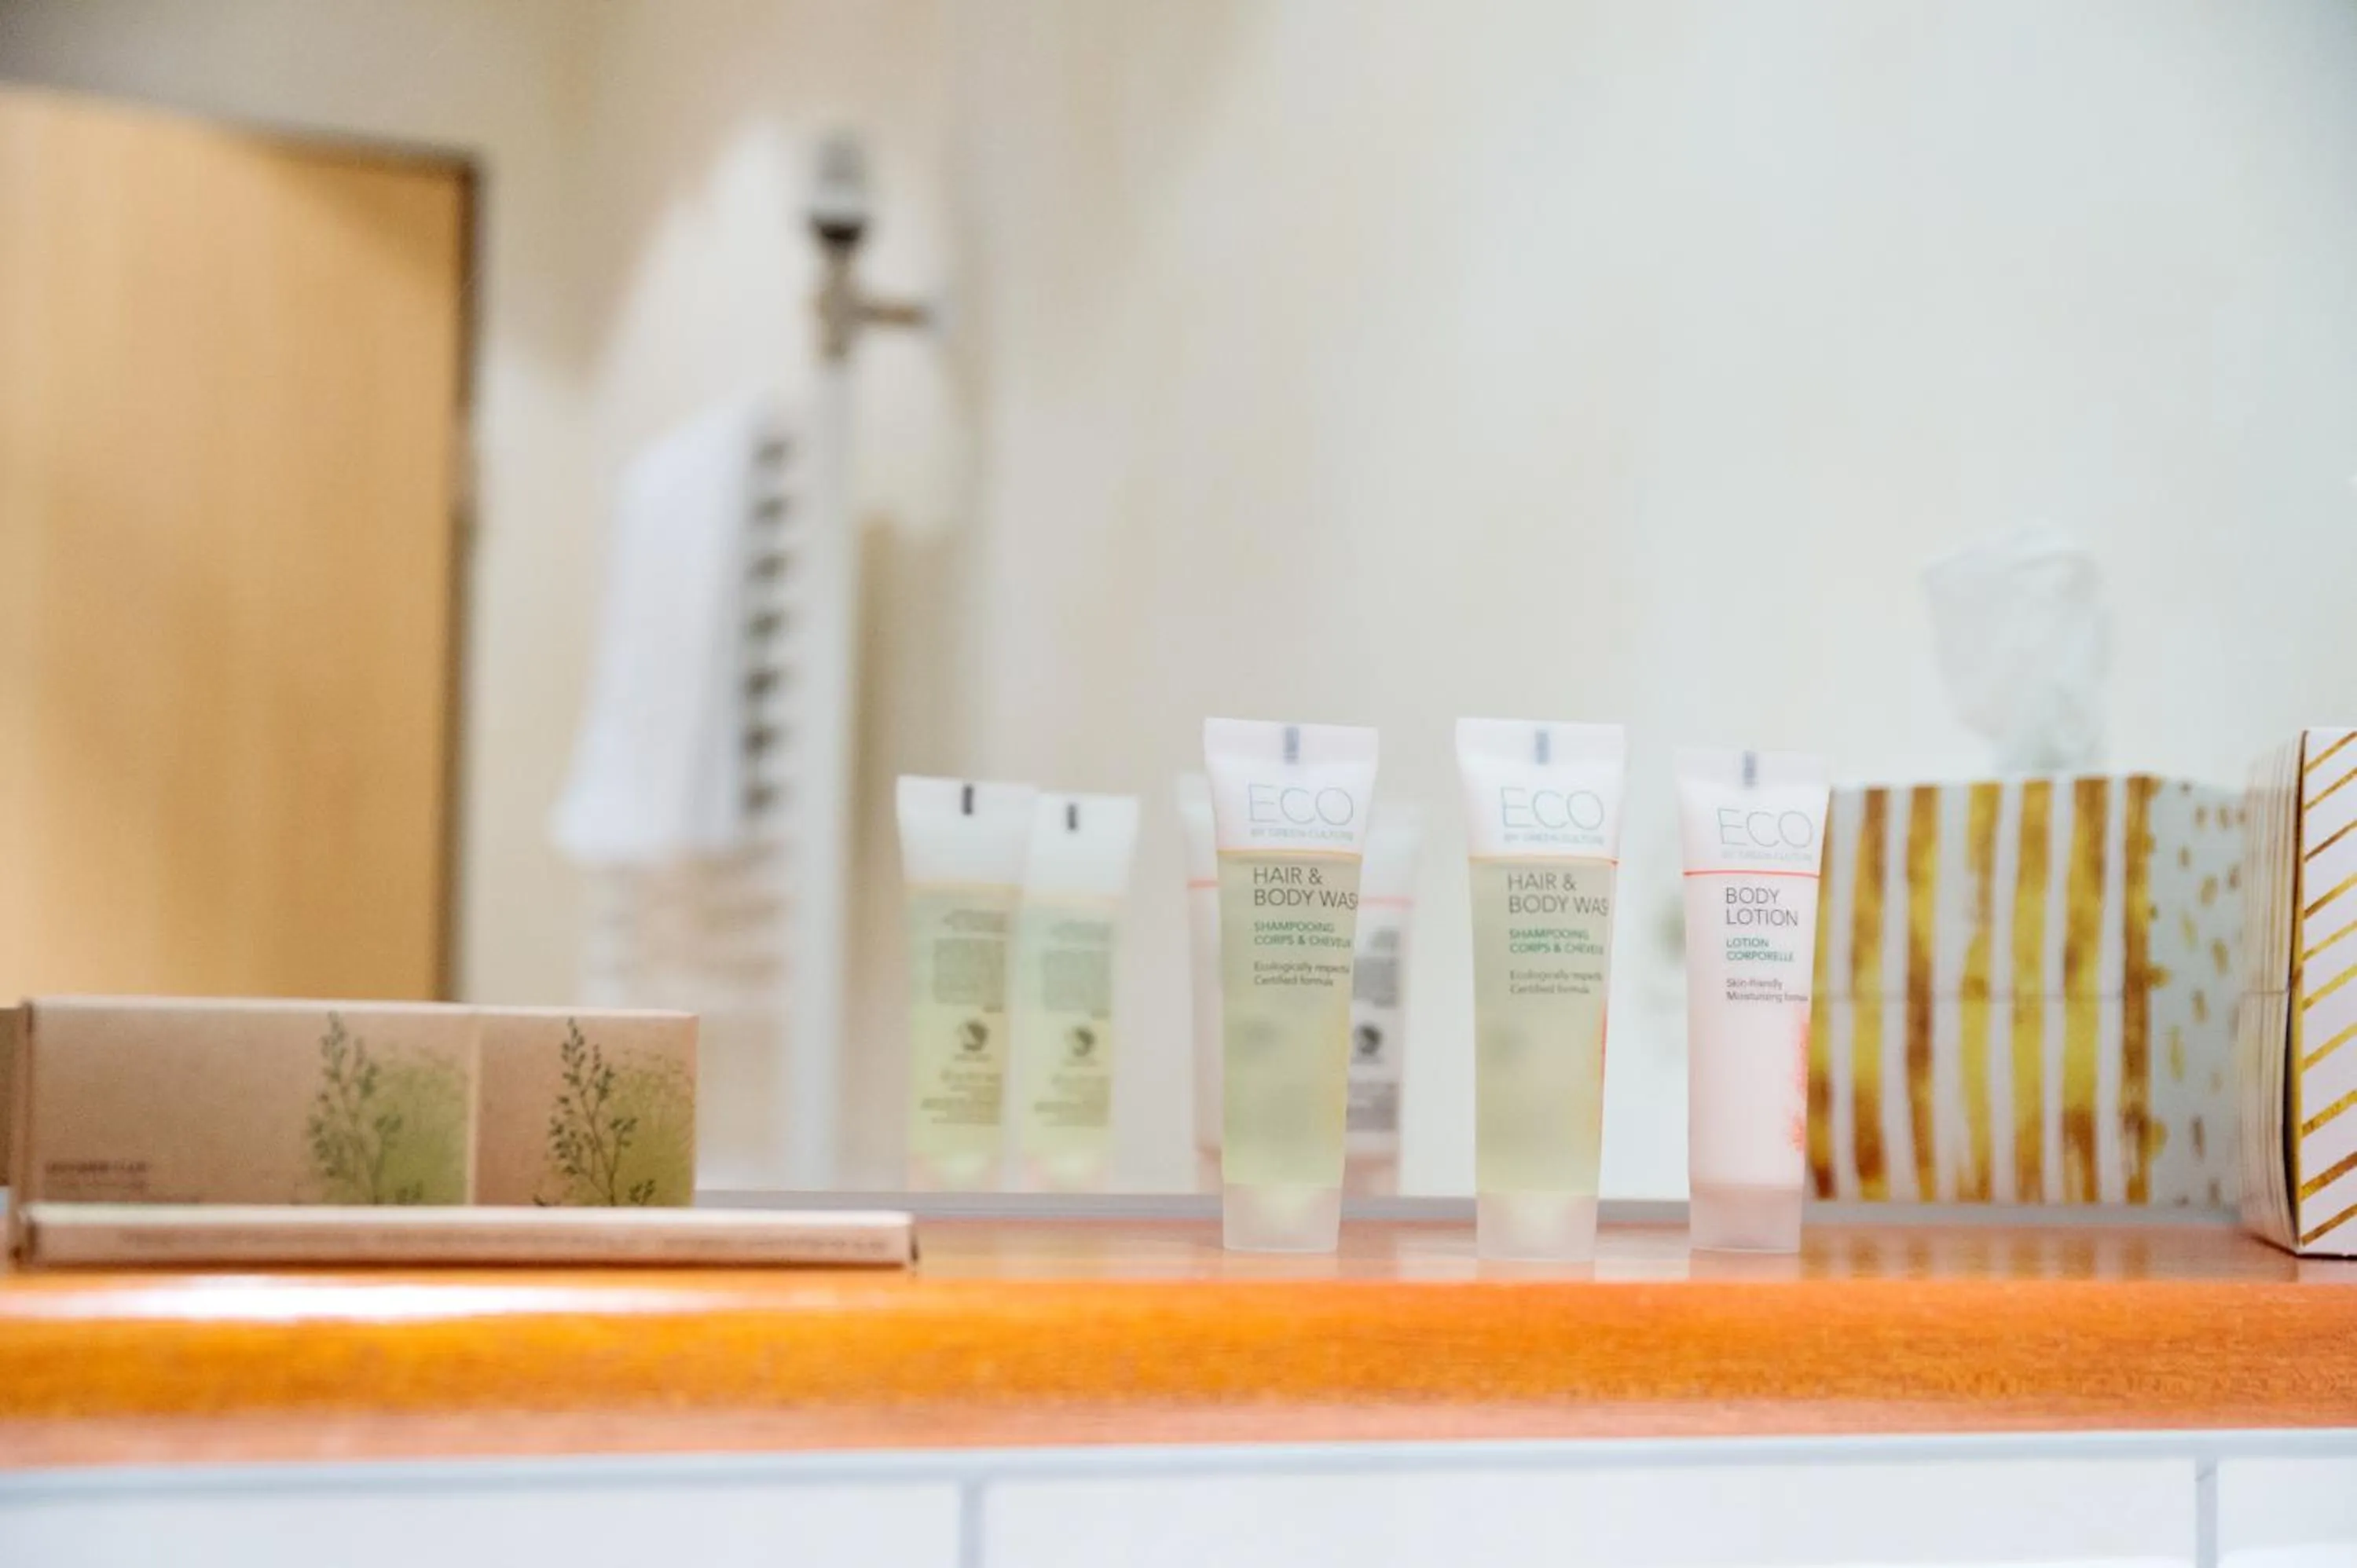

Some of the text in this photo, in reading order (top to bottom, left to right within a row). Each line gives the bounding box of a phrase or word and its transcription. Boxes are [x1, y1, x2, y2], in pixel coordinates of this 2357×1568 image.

[1248, 783, 1354, 826] ECO
[1500, 786, 1605, 831] ECO
[1717, 807, 1813, 849] ECO
[1254, 866, 1323, 885] HAIR &
[1508, 872, 1578, 892] HAIR &
[1254, 888, 1314, 907] BODY
[1508, 894, 1570, 914] BODY
[1725, 886, 1781, 904] BODY
[1726, 907, 1798, 926] LOTION
[1254, 921, 1335, 933] SHAMPOOING
[1509, 929, 1589, 940] SHAMPOOING
[1255, 935, 1294, 946] CORPS
[1298, 935, 1306, 946] &
[1509, 943, 1551, 954] CORPS
[1553, 943, 1562, 954] &
[1726, 937, 1770, 947] LOTION
[1726, 951, 1795, 962] CORPORELLE
